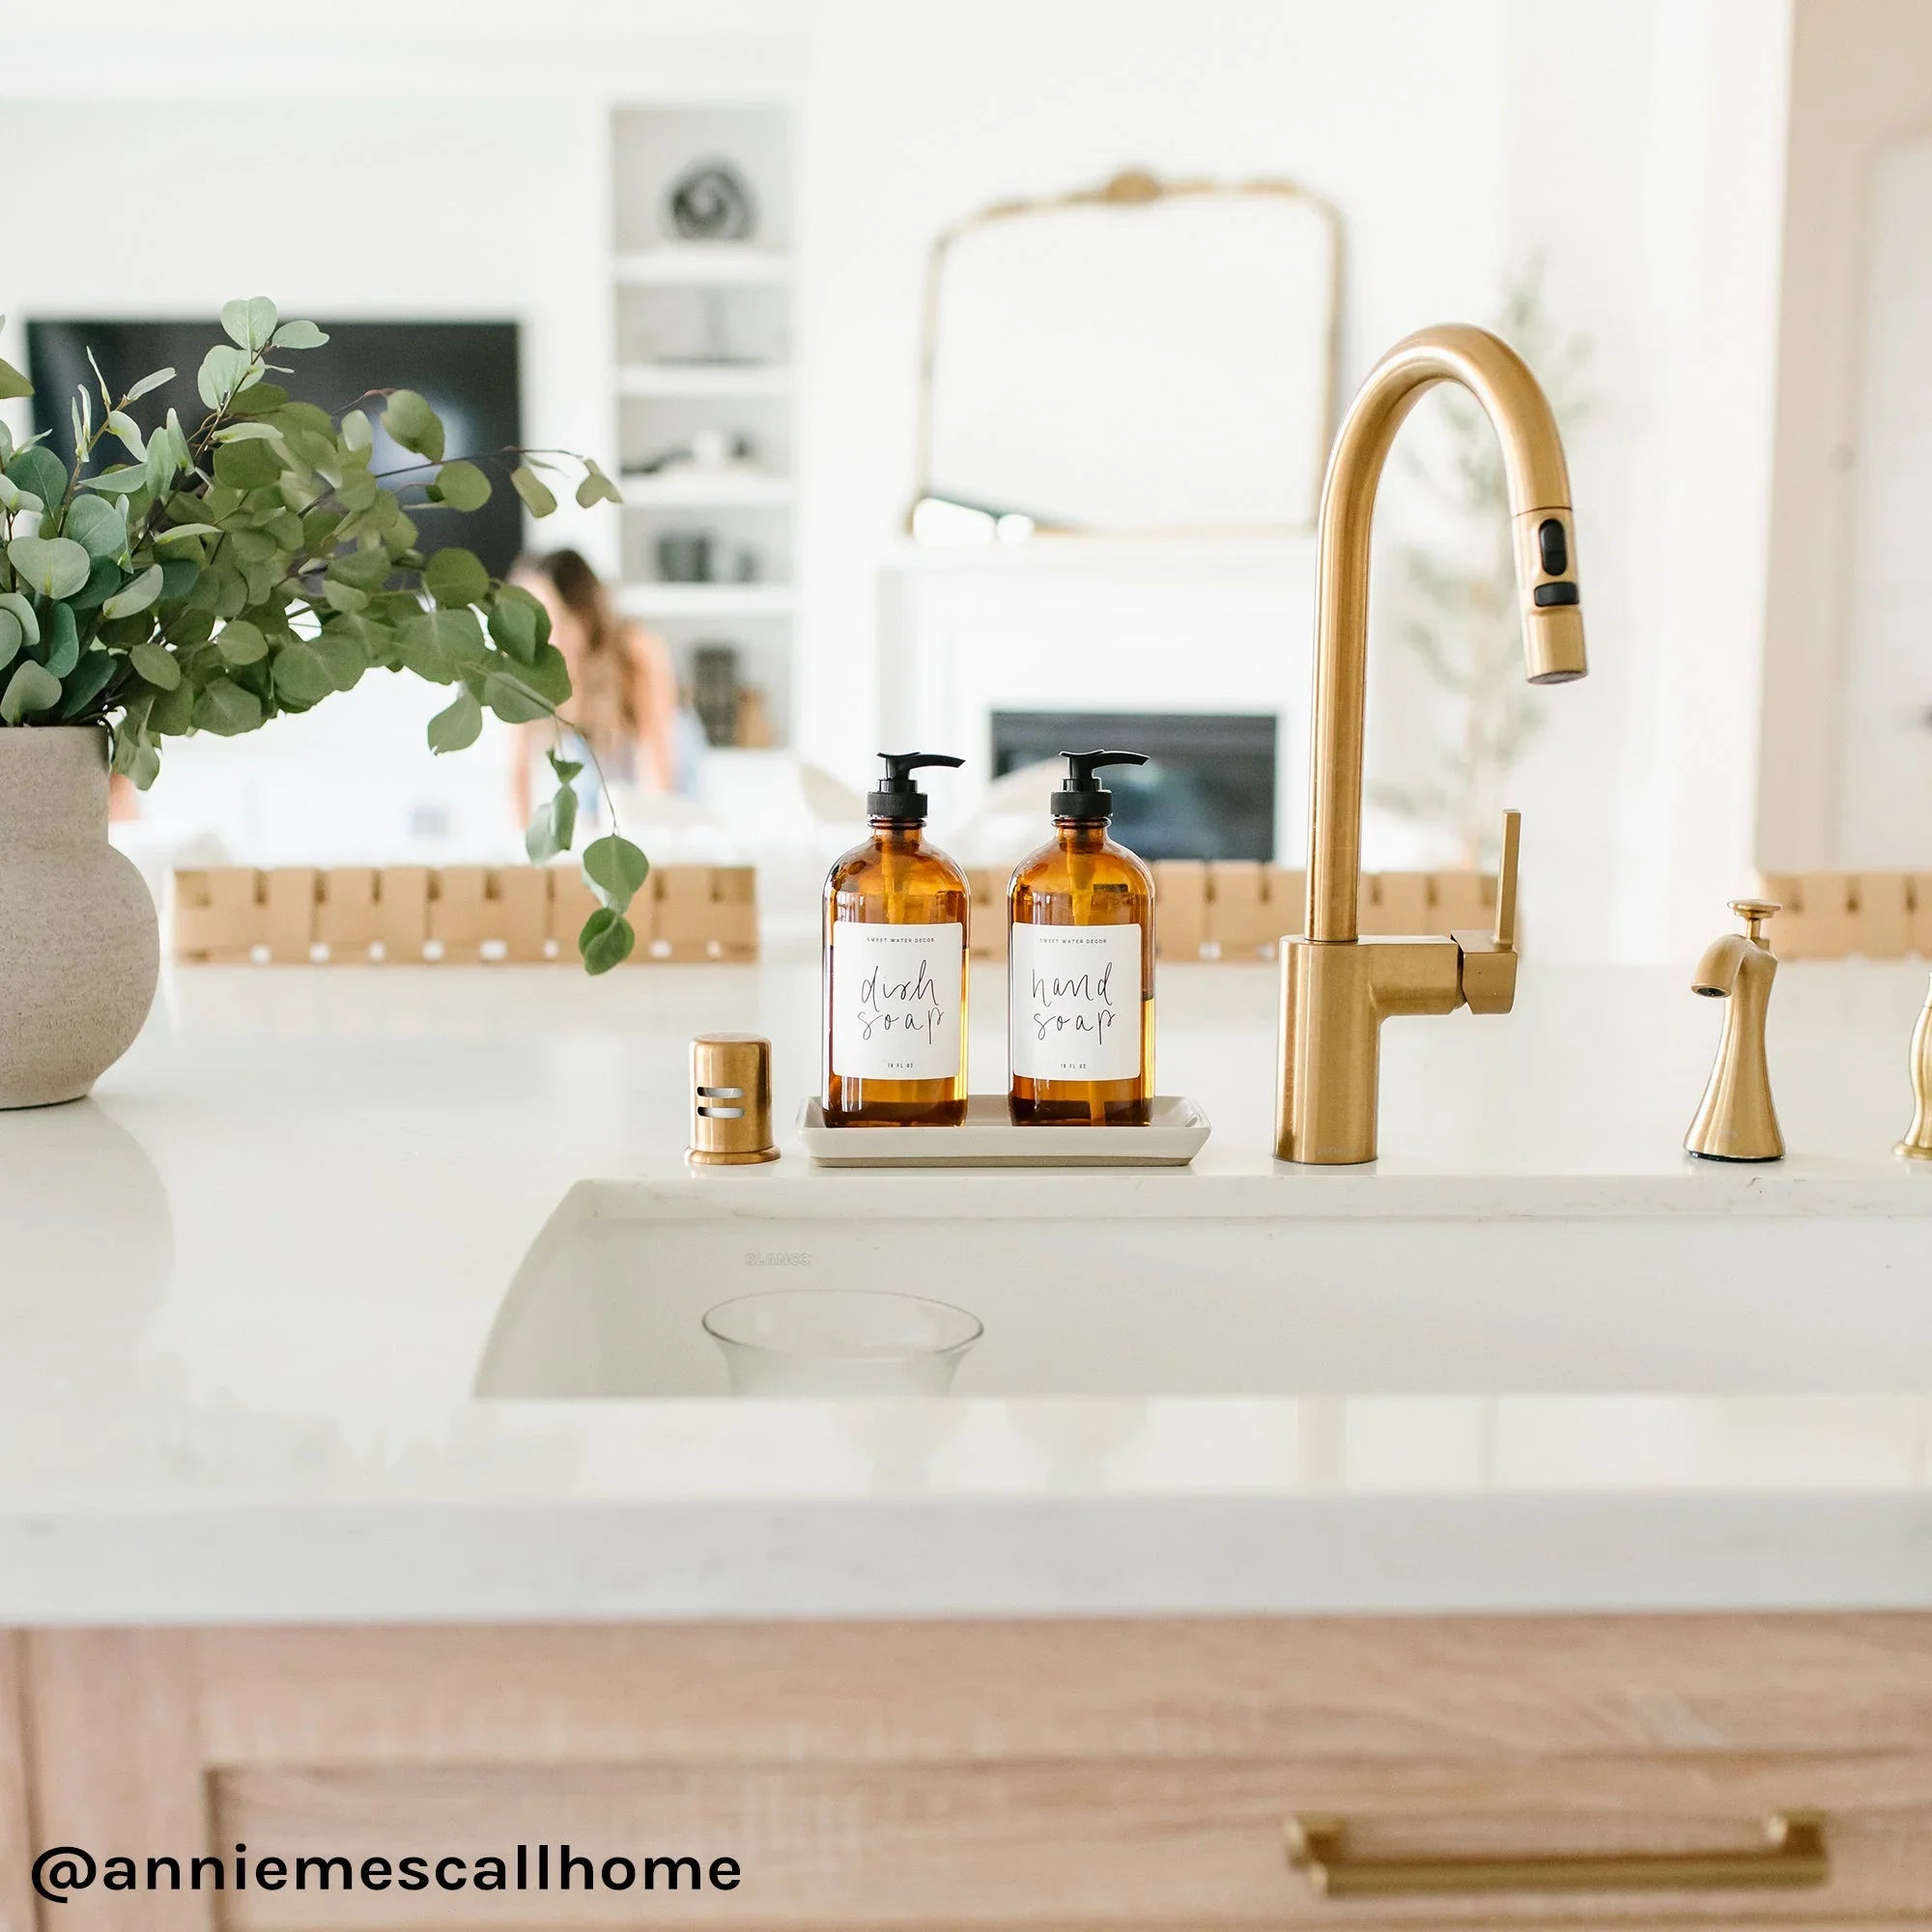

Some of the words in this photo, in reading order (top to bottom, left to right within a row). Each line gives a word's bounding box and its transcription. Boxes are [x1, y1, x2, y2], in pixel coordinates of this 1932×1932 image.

[861, 959, 939, 1012] dish
[1032, 961, 1113, 1008] hand
[857, 1007, 945, 1045] soap
[1033, 1009, 1116, 1045] soap
